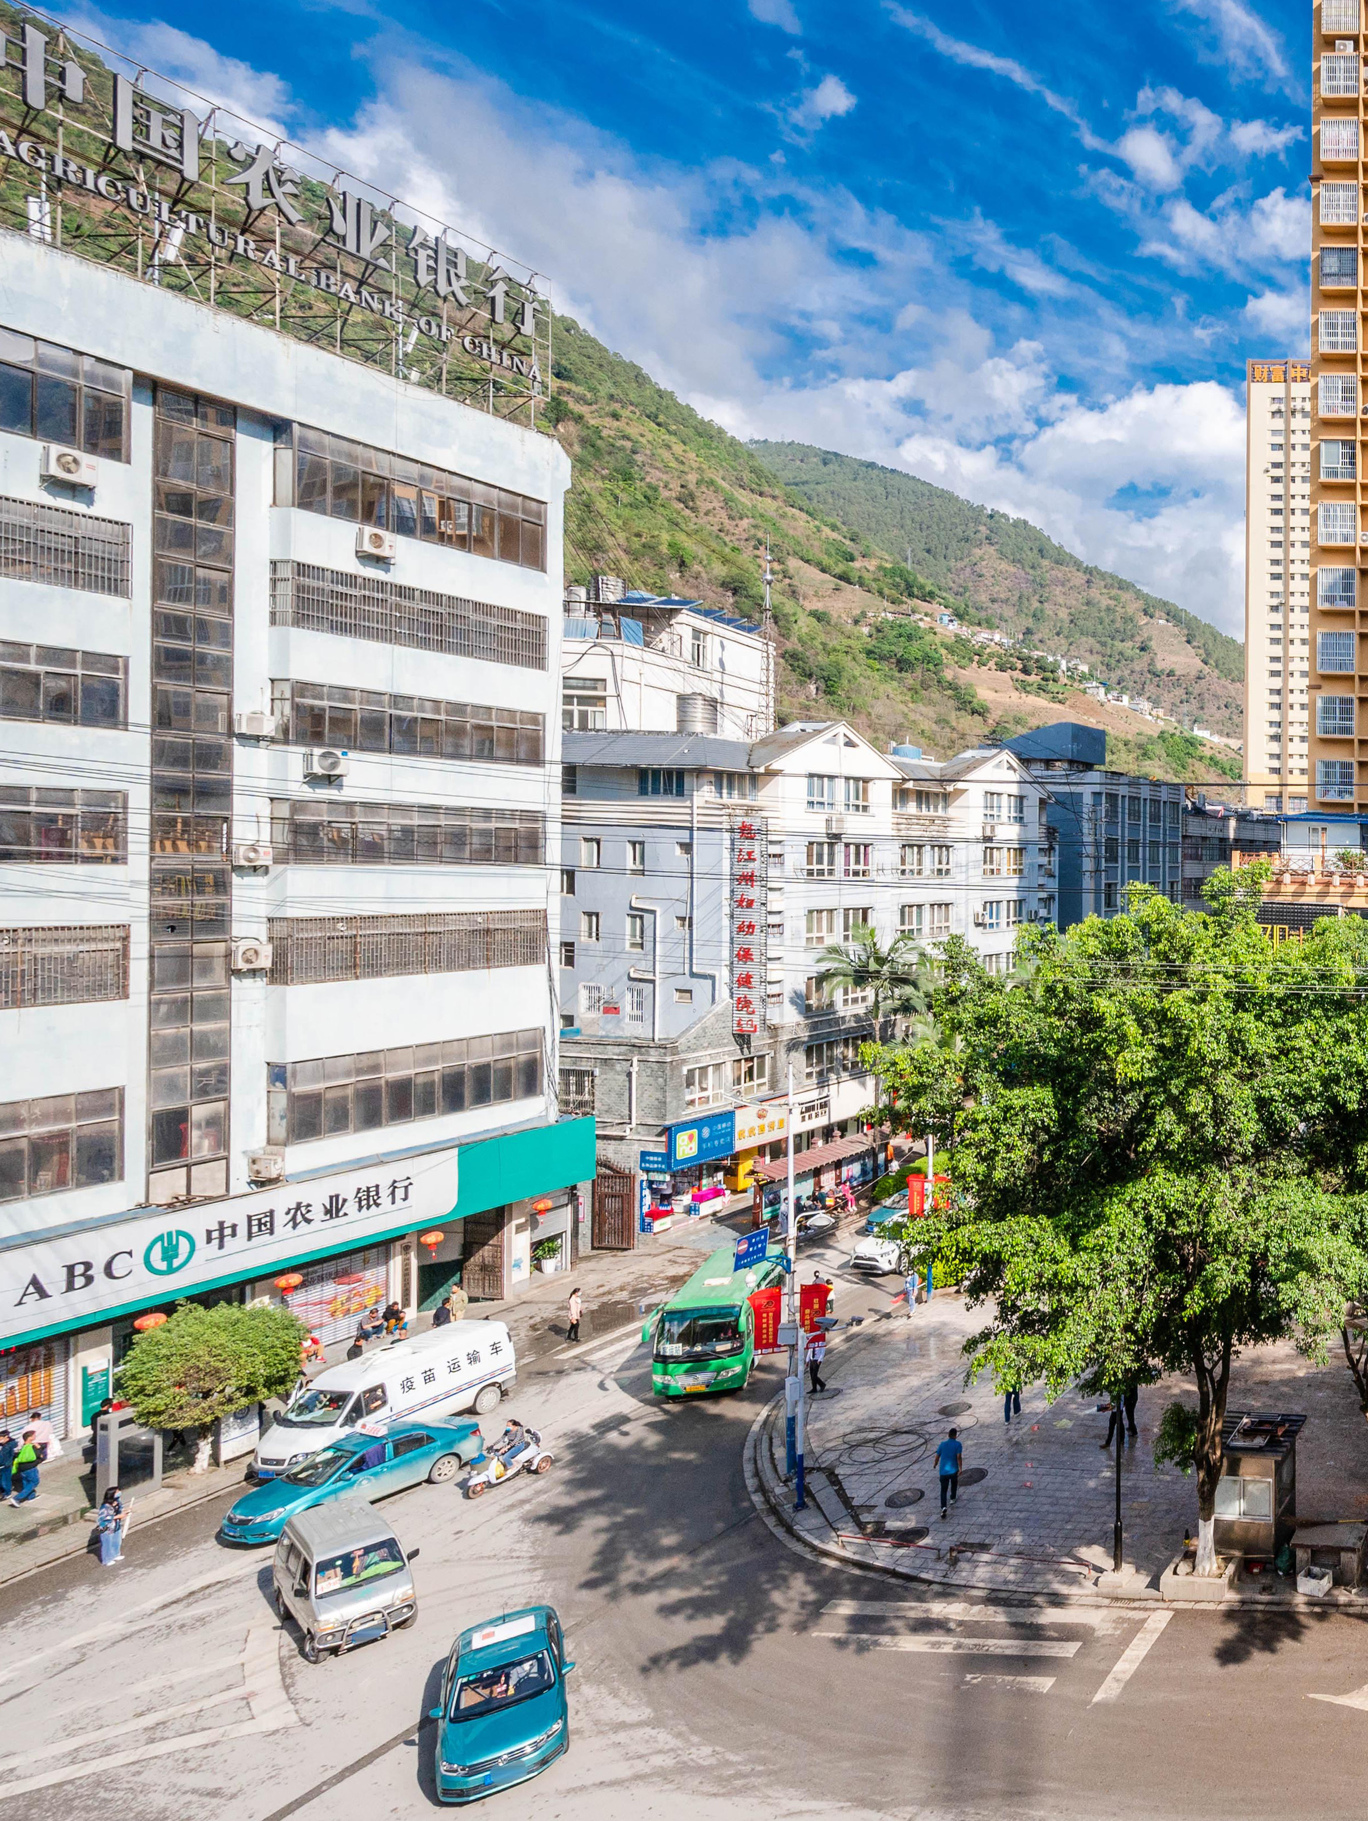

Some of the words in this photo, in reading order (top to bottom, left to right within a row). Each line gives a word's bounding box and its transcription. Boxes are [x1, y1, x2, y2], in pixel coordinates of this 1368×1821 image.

[0, 22, 543, 338] 中国农业银行
[0, 129, 308, 285] AGRICULTURAL
[316, 269, 401, 321] BANK
[417, 315, 456, 343] OF
[461, 334, 543, 383] CHINA
[1253, 364, 1311, 383] 财富中
[205, 1174, 415, 1252] 中国农业银行
[14, 1249, 135, 1307] ABC
[399, 1340, 504, 1394] 疫苗运输车
